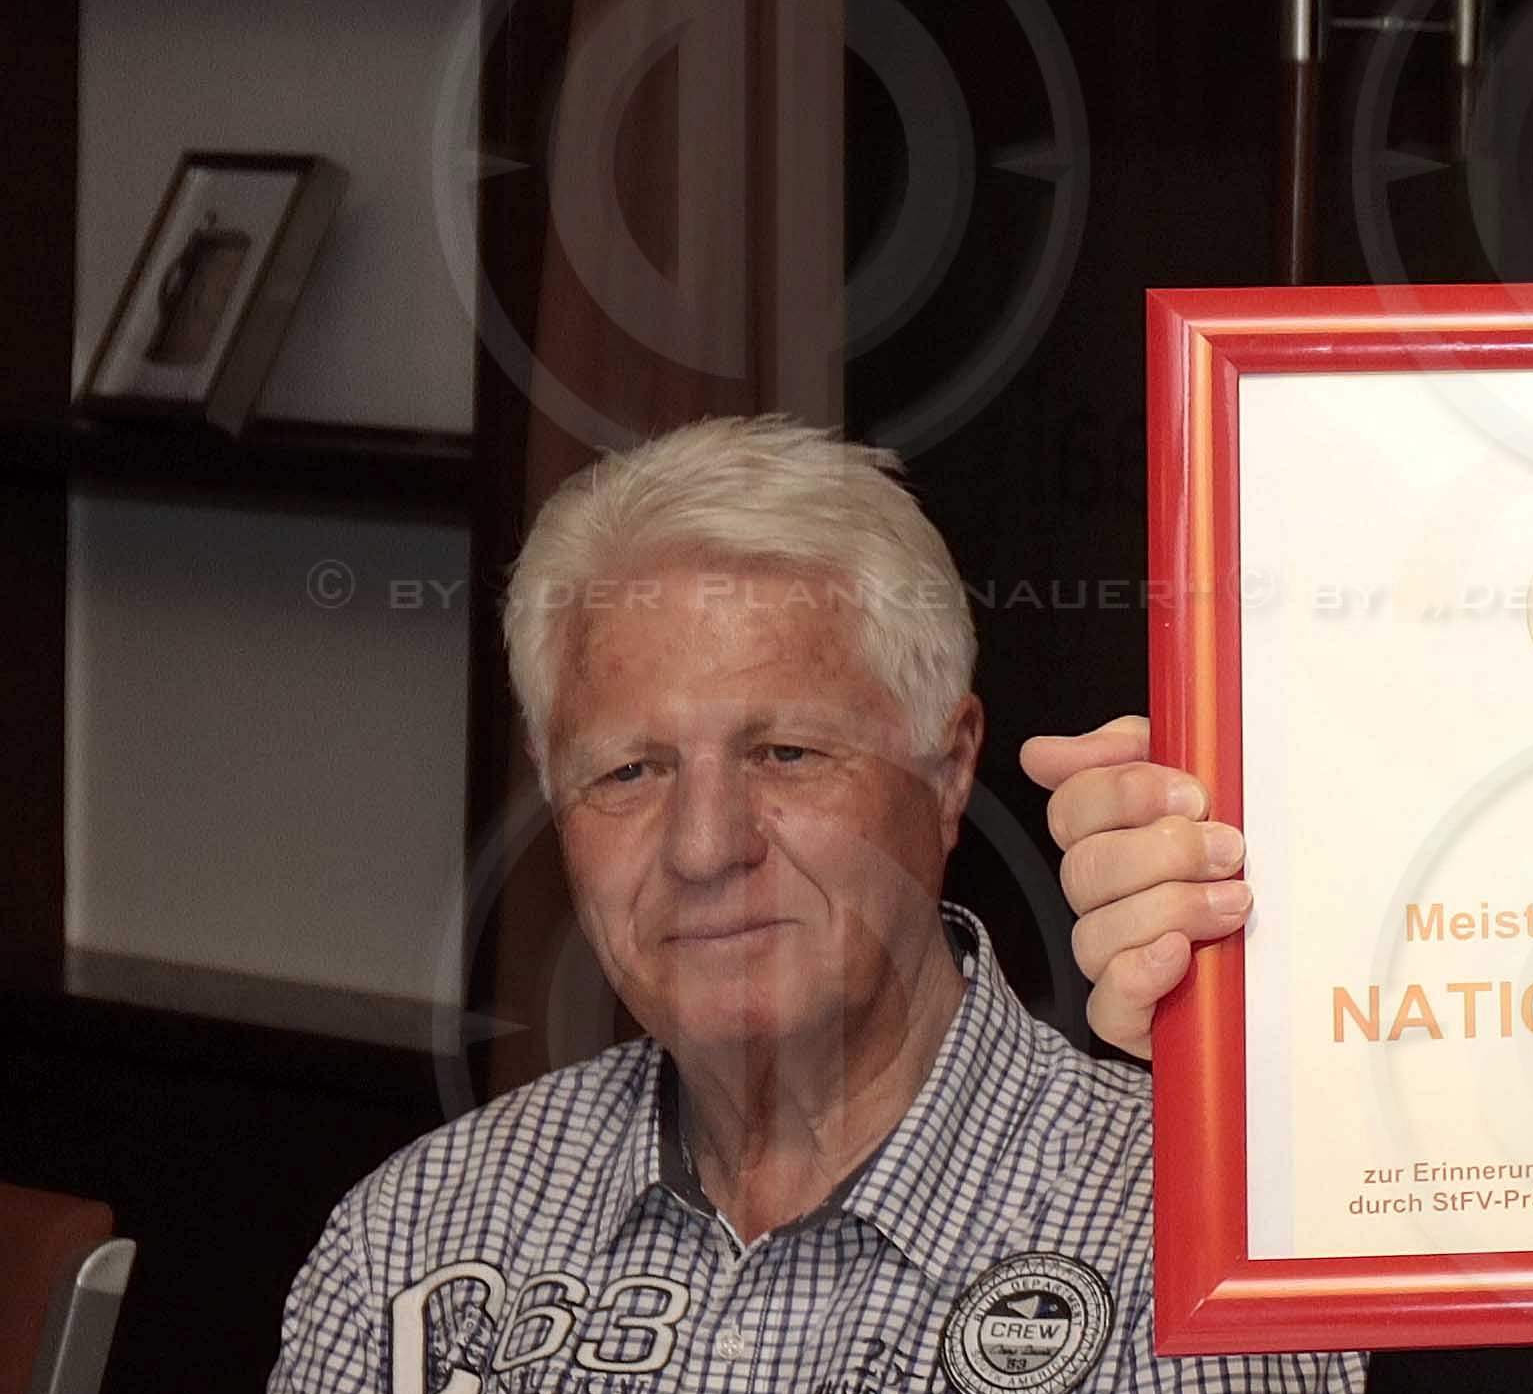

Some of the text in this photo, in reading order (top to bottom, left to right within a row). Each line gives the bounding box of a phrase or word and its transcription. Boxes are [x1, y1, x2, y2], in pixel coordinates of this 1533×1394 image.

[1364, 1169, 1403, 1184] zur
[1349, 1194, 1423, 1215] durch
[991, 1322, 1061, 1339] CREW
